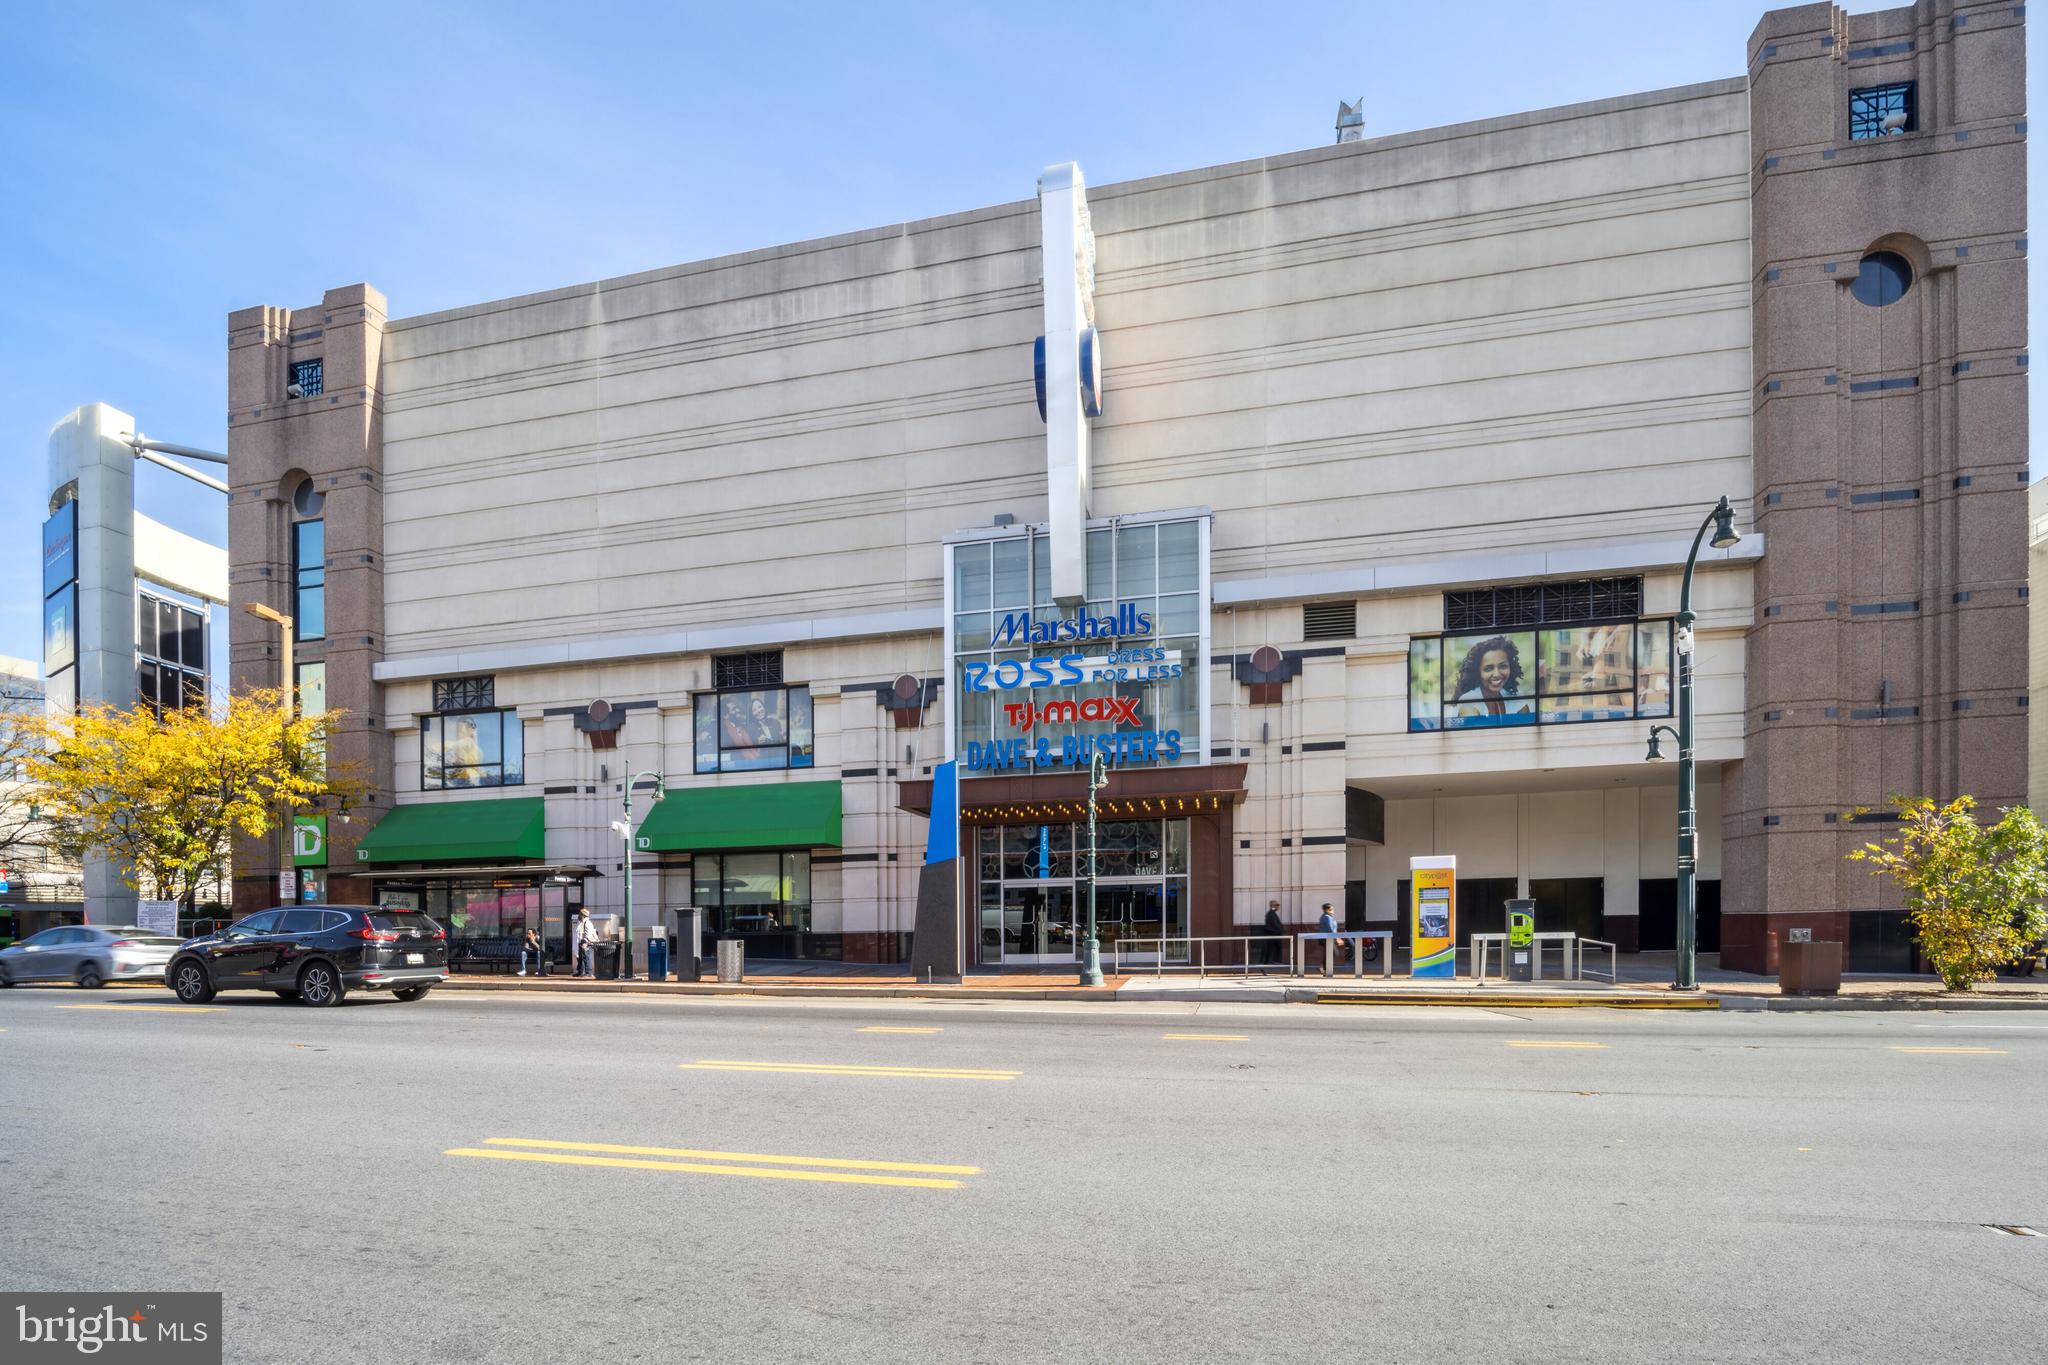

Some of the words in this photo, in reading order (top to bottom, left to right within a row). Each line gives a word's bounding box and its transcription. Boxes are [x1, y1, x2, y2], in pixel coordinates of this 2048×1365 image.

[991, 602, 1152, 647] Marshalls
[1107, 647, 1166, 665] DRESS
[965, 653, 1084, 694] ROSS
[1092, 668, 1129, 684] FOR
[1136, 664, 1182, 682] LESS
[967, 737, 1028, 771] DAVE
[1034, 736, 1054, 768] &
[1063, 729, 1182, 767] BUSTER'S
[636, 837, 650, 848] TD
[356, 849, 369, 860] TD
